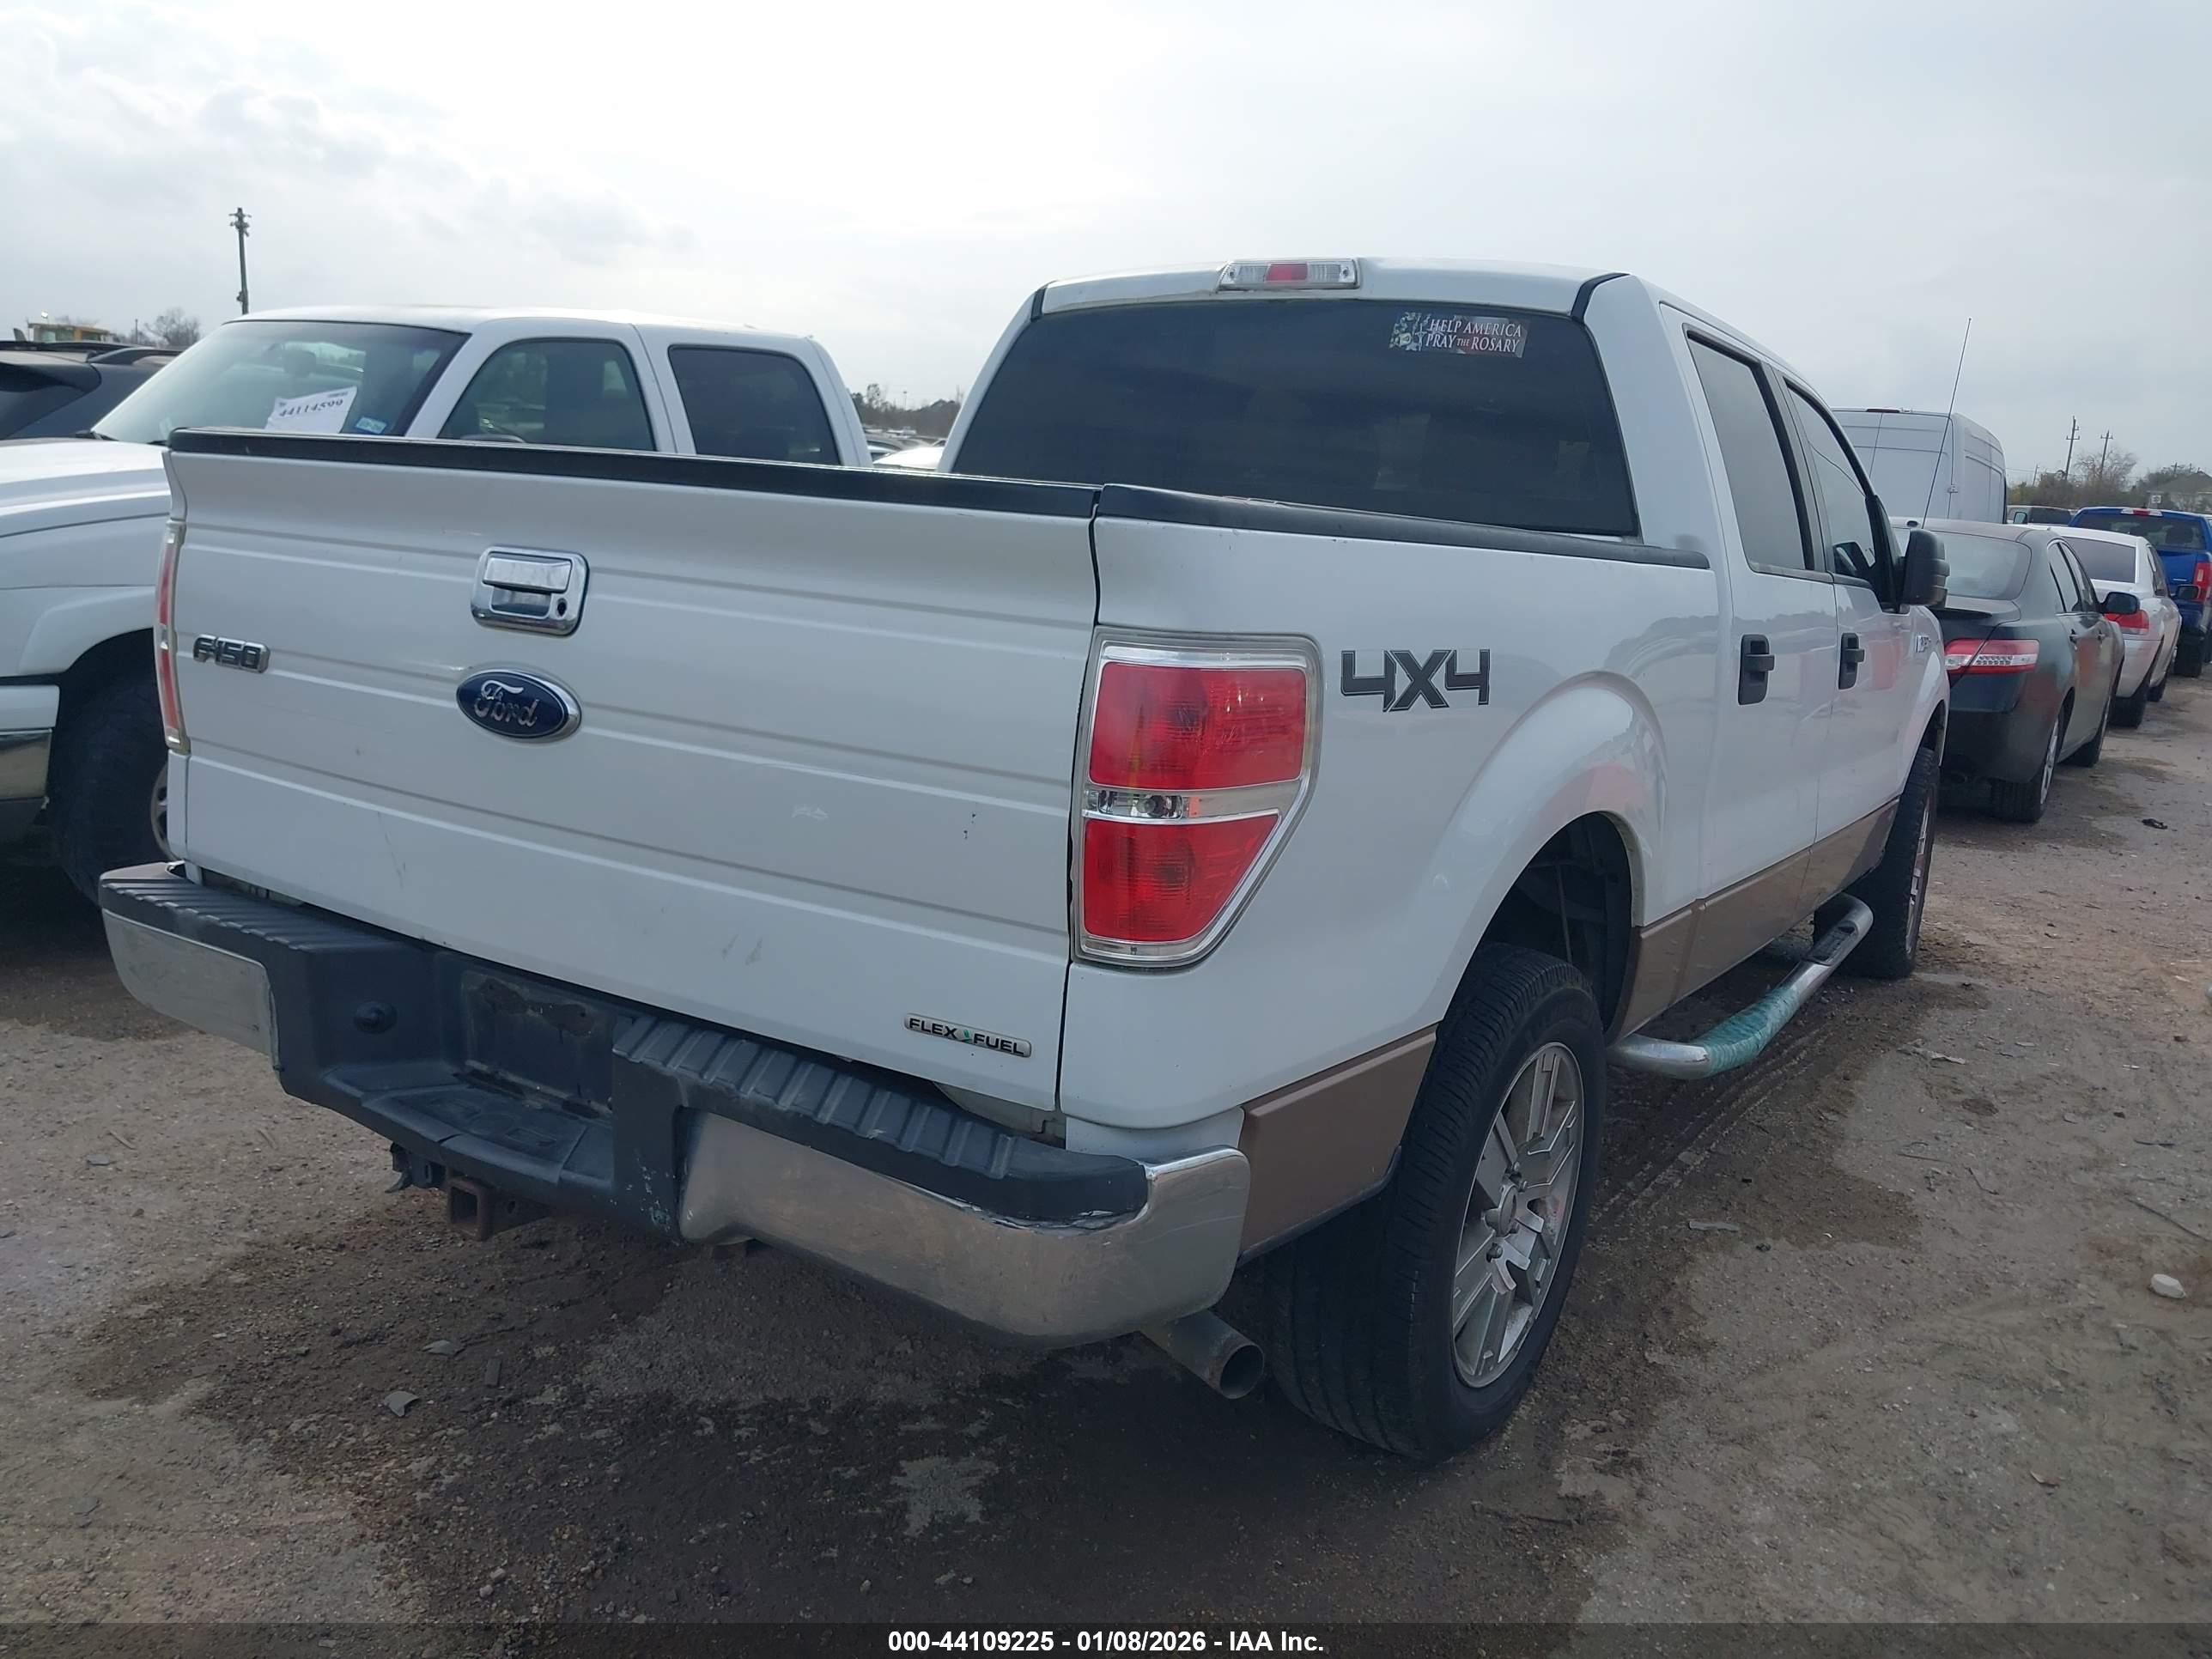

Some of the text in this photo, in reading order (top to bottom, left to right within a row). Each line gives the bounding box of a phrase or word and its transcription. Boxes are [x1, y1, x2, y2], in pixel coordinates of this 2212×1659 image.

[1429, 319, 1522, 337] HELP AMERICA
[1425, 333, 1520, 353] PRAY THE ROSARY
[473, 679, 540, 728] Ford
[908, 1018, 1025, 1054] FLEX FUEL
